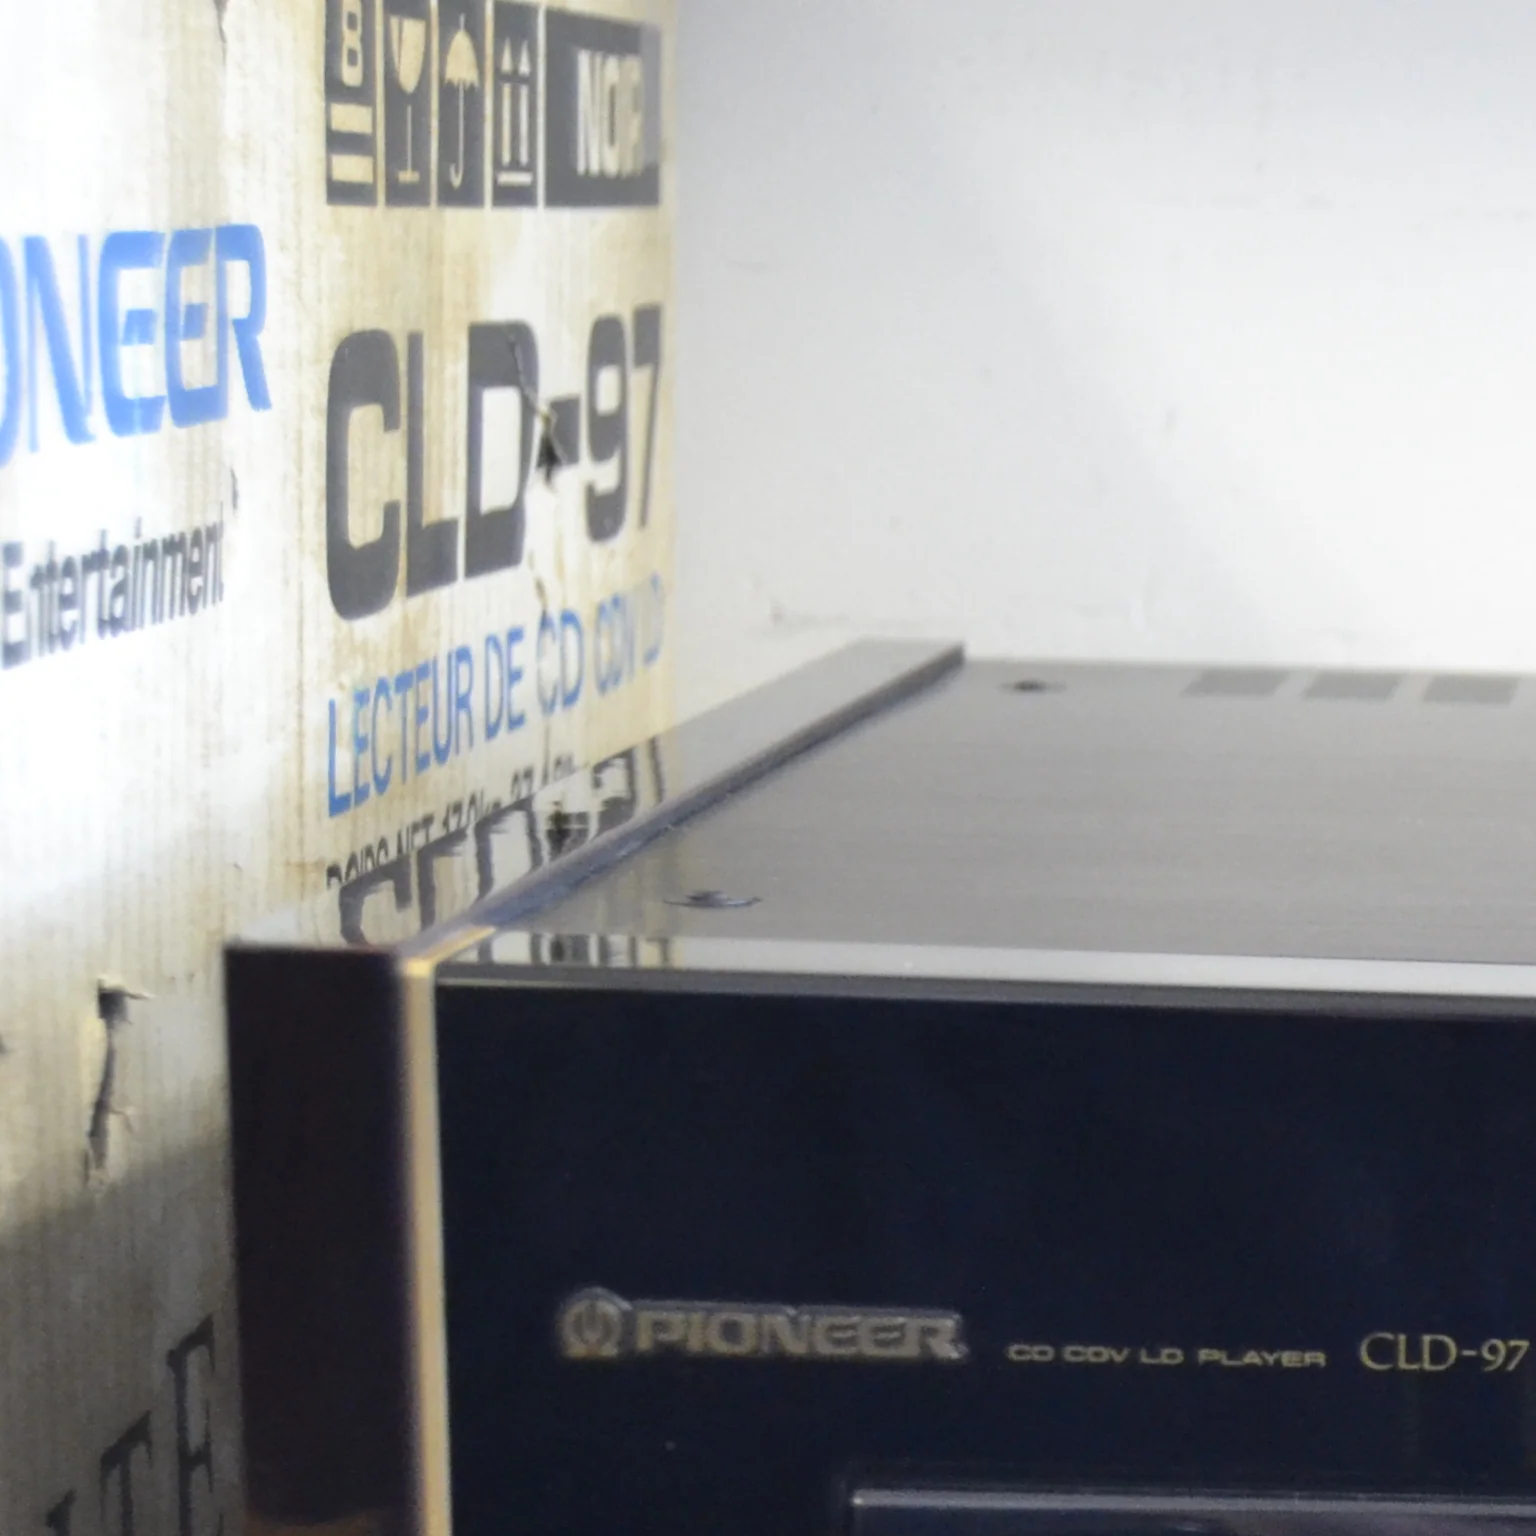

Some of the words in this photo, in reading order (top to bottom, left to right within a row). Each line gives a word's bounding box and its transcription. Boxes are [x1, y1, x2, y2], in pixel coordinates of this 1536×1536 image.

[326, 303, 662, 622] CLD-97
[328, 645, 474, 819] LECTEUR
[484, 626, 526, 742] DE
[536, 608, 585, 716] CD
[634, 1303, 968, 1359] PIONEER
[1007, 1343, 1054, 1361] CD
[1063, 1344, 1130, 1363] CDV
[1139, 1346, 1184, 1364] LD
[1199, 1348, 1327, 1367] PLAYER
[1359, 1332, 1531, 1372] CLD-97
